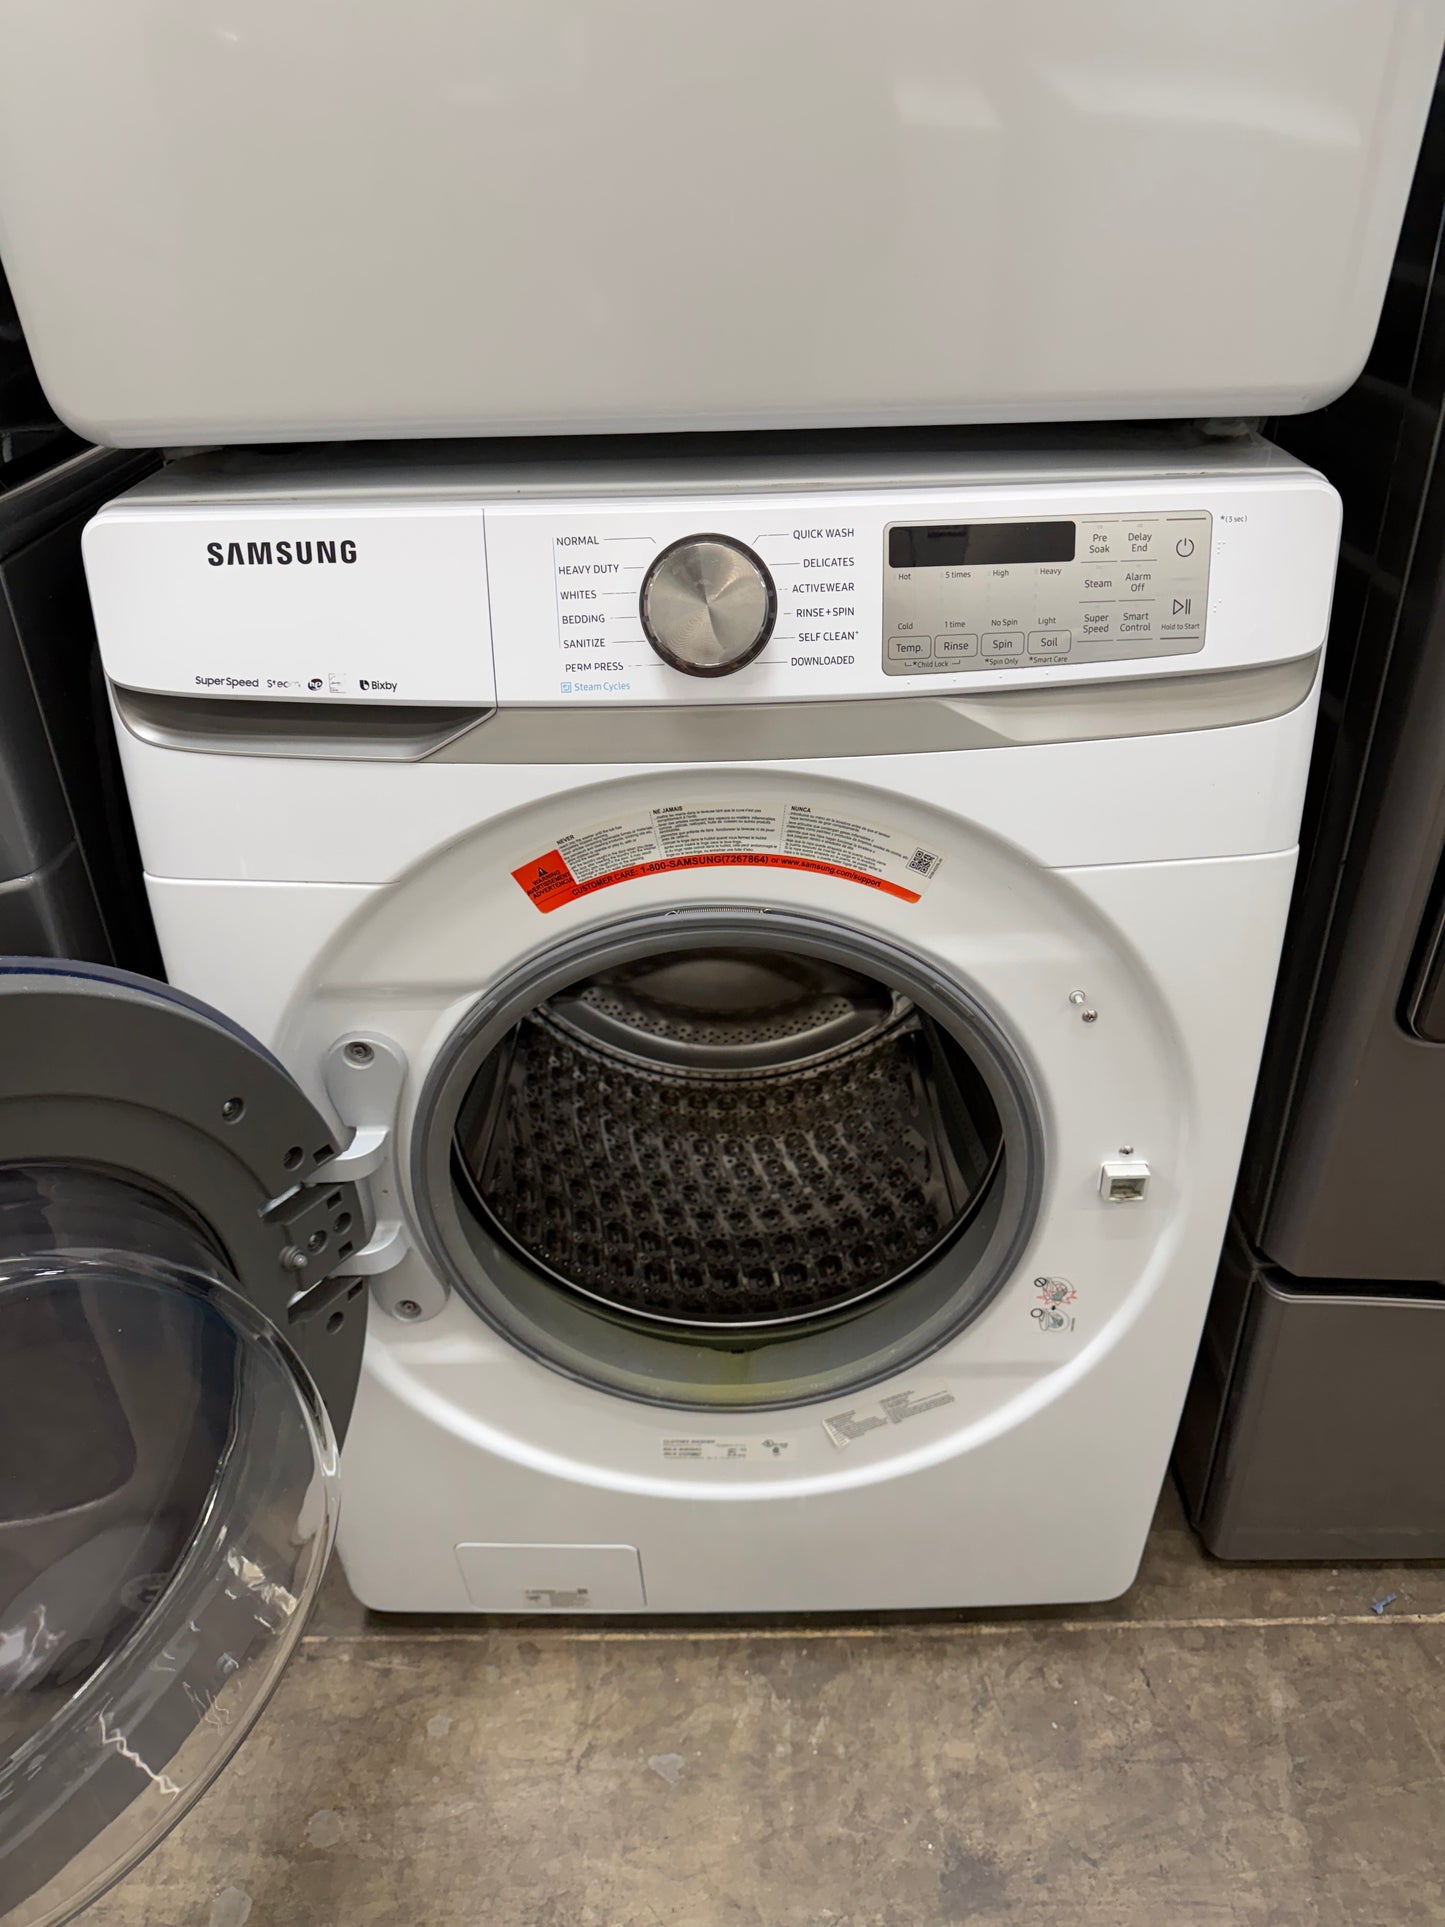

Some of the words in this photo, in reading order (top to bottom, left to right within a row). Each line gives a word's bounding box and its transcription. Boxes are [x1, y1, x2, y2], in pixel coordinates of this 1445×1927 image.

[793, 528, 824, 539] QUICK
[825, 527, 855, 538] WASH
[1092, 534, 1107, 542] Pre
[1128, 532, 1152, 542] Delay
[556, 536, 599, 546] NORMAL
[1089, 545, 1110, 554] Soak
[1131, 543, 1148, 552] End
[207, 539, 357, 567] SAMSUNG
[803, 557, 855, 568] DELICATES
[558, 565, 591, 575] HEAVY
[593, 564, 620, 574] DUTY
[992, 569, 1009, 577] High
[1040, 567, 1062, 576] Heavy
[1125, 572, 1152, 581] Alarm
[792, 582, 855, 593] ACTIVEWEAR
[1084, 579, 1112, 588] Steam
[1130, 583, 1145, 592] Off
[560, 590, 597, 600] WHITES
[796, 607, 824, 618] RINSE
[833, 607, 855, 617] SPIN
[1123, 612, 1149, 621] Smart
[562, 614, 605, 625] BEDDING
[1002, 618, 1018, 627] Spin
[1038, 617, 1056, 625] Light
[1084, 613, 1109, 623] Super
[897, 622, 913, 630] Cold
[949, 620, 966, 628] time
[1083, 624, 1109, 634] Speed
[1120, 622, 1151, 632] Control
[798, 632, 821, 642] SELF
[1041, 637, 1058, 647] Soil
[563, 638, 606, 649] SANITIZE
[896, 643, 923, 654] Temp.
[944, 641, 969, 650] Rinse
[992, 639, 1013, 650] Spin
[791, 655, 855, 666] DOWNLOADED
[934, 660, 949, 668] Lock
[1003, 657, 1019, 665] Only
[1053, 655, 1068, 663] Care
[565, 663, 592, 672] PERM
[594, 662, 624, 671] PRESS
[195, 675, 225, 687] Super
[226, 677, 259, 689] Speed
[372, 680, 398, 693] Bixby
[574, 683, 602, 692] Steam
[603, 682, 631, 692] Cycles
[662, 806, 683, 814] JAMAIS
[791, 805, 811, 813] NUNCA
[556, 834, 575, 845] NEVER
[571, 875, 615, 897] CUSTOMER
[614, 869, 638, 881] CARE:
[640, 855, 769, 874] 1-800-SAMSUNG(7267864)
[781, 858, 882, 888] www.samsung.com/support
